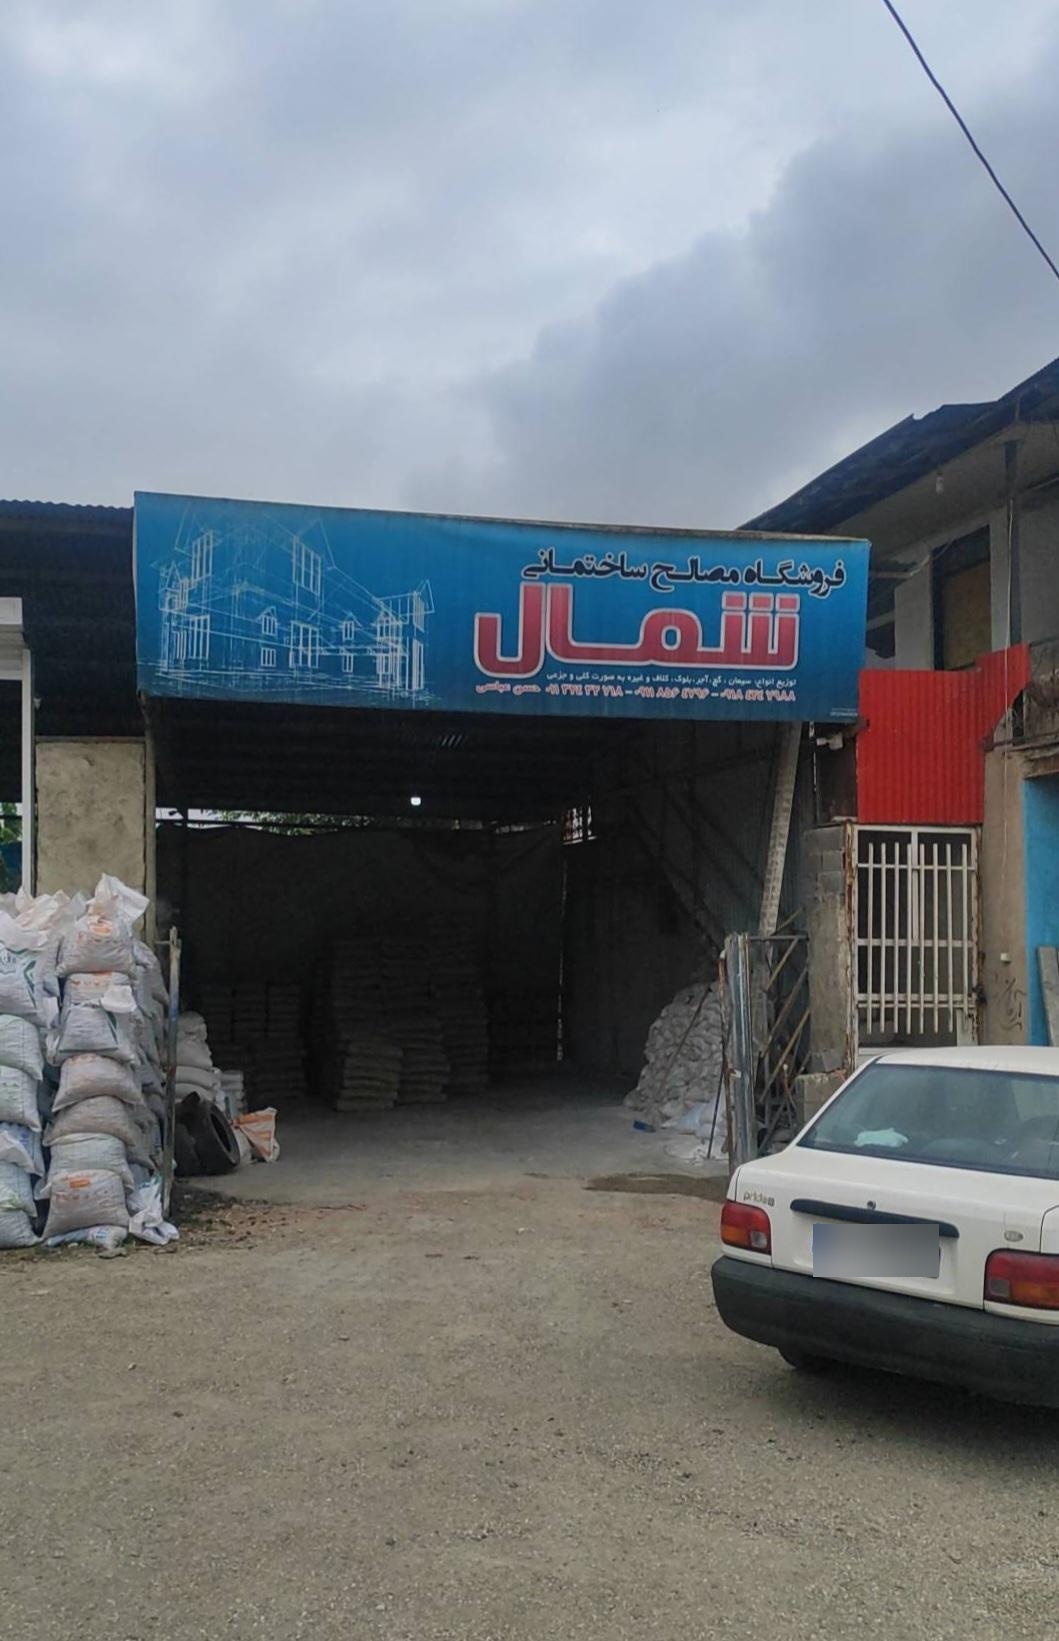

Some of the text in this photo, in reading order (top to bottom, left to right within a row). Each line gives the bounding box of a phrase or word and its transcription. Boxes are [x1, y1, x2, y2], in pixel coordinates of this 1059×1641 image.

[521, 547, 845, 598] فروشگاه مصالح ساختمانی
[474, 580, 801, 678] شمال
